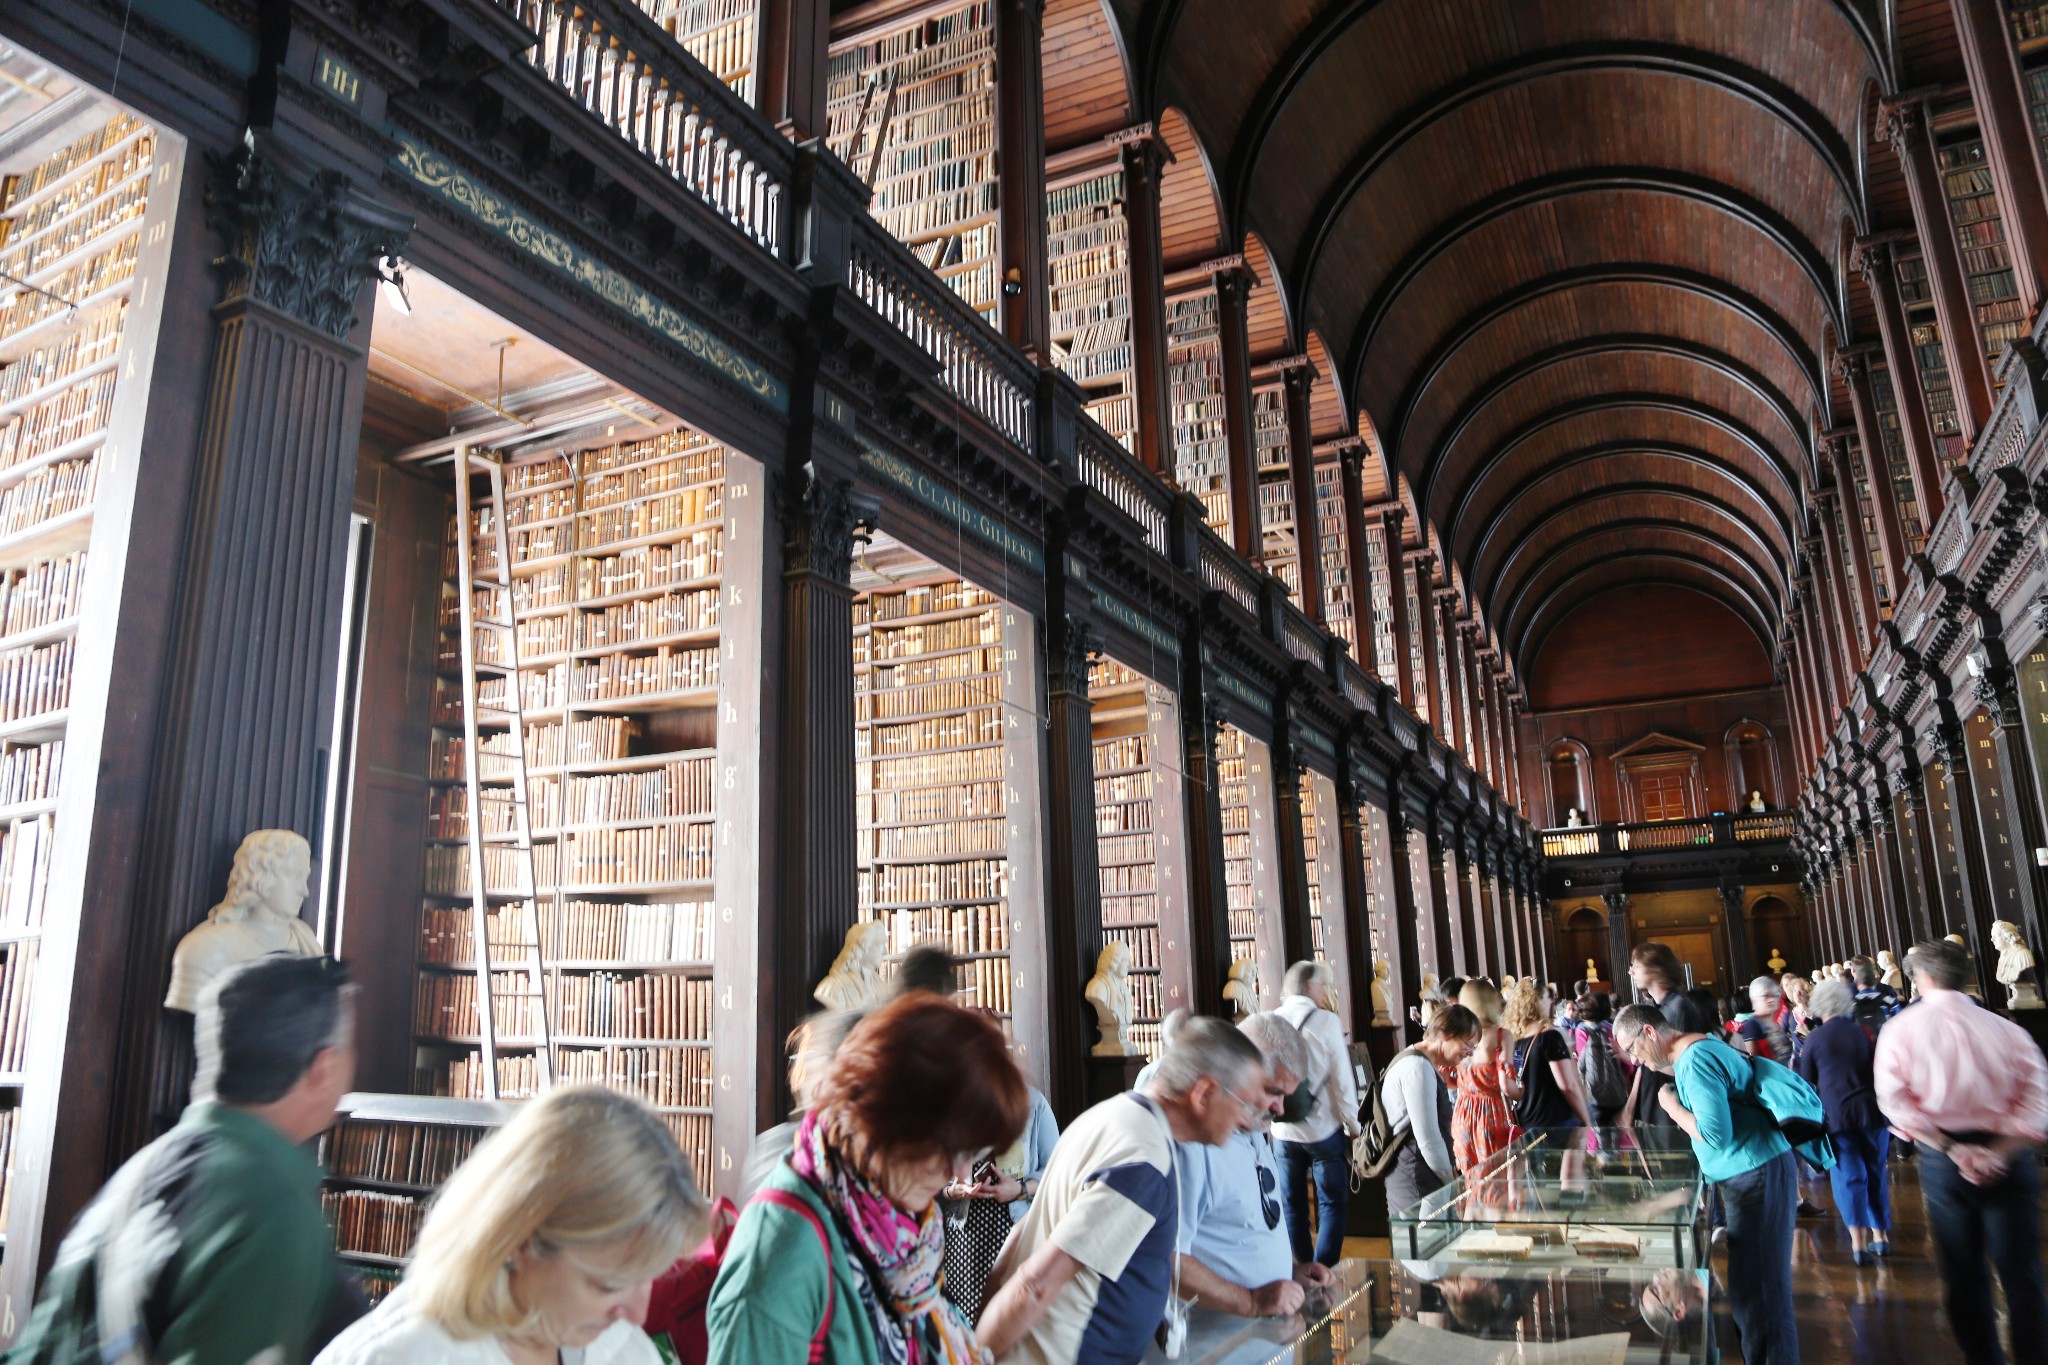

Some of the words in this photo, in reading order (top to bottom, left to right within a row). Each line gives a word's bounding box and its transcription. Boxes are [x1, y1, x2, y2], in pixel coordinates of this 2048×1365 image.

[322, 59, 358, 102] HH
[158, 161, 170, 185] n
[148, 219, 166, 246] m
[124, 347, 136, 378] k
[731, 481, 749, 499] m
[918, 476, 977, 528] CLAUD:
[980, 516, 1034, 563] GILBERT
[729, 585, 743, 606] k
[1006, 614, 1015, 626] n
[728, 640, 735, 660] i
[1005, 648, 1017, 661] m
[2031, 653, 2046, 663] m
[725, 702, 738, 723] h
[1151, 710, 1162, 721] m
[1008, 715, 1018, 728] k
[1980, 739, 1991, 748] m
[1010, 752, 1015, 767] i
[724, 765, 737, 790] g
[1010, 788, 1019, 804] h
[1991, 788, 1998, 797] k
[721, 820, 732, 846] f
[2000, 834, 2008, 844] h
[723, 906, 733, 922] e
[1014, 919, 1022, 932] e
[1015, 972, 1025, 990] d
[721, 986, 733, 1010] d
[1170, 985, 1179, 998] d
[720, 1074, 731, 1090] c
[721, 1147, 732, 1171] b
